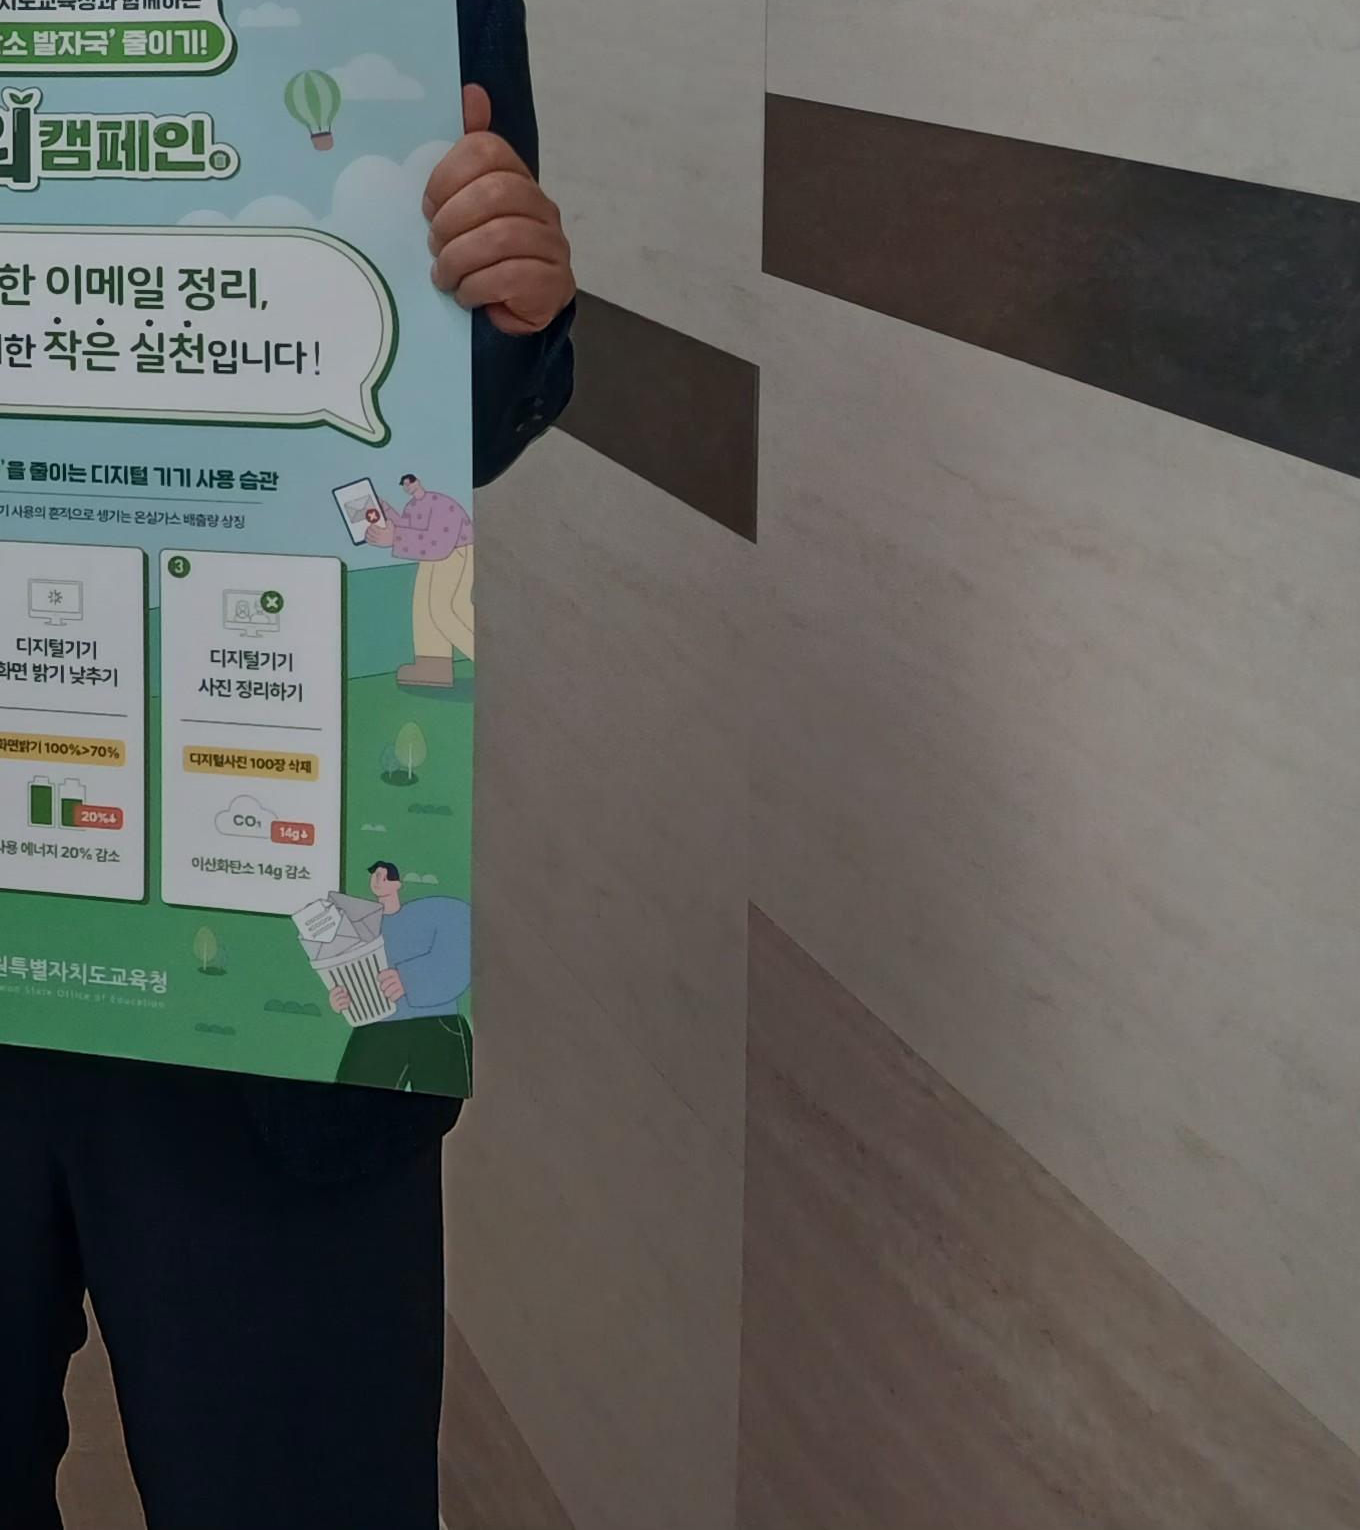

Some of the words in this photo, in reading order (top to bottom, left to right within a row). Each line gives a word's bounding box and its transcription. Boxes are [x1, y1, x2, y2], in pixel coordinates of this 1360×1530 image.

[33, 28, 115, 56] 발자국’
[122, 29, 208, 56] 줄이기!
[46, 264, 165, 310] 이메일
[177, 266, 268, 311] 정리,
[43, 329, 121, 372] 작은
[130, 332, 321, 376] 실천입니다!
[29, 461, 87, 483] 줄이는
[91, 464, 148, 486] 디지털
[153, 466, 191, 488] 기기
[196, 469, 235, 490] 사용
[239, 470, 279, 491] 습관
[11, 504, 46, 519] 사용의
[134, 511, 181, 525] 온실가스
[16, 637, 97, 660] 디지털기기
[210, 648, 293, 672] 디지털기기
[32, 664, 65, 684] 밝기
[69, 666, 118, 688] 낮추기
[198, 678, 232, 698] 사진
[236, 680, 303, 702] 정리하기
[190, 752, 248, 769] 디지털사진
[20, 841, 58, 859] 에너지
[61, 846, 92, 860] 20%
[95, 848, 120, 863] 감소
[192, 856, 255, 874] 이산화탄소
[258, 864, 283, 880] 14g
[285, 864, 311, 880] 감소
